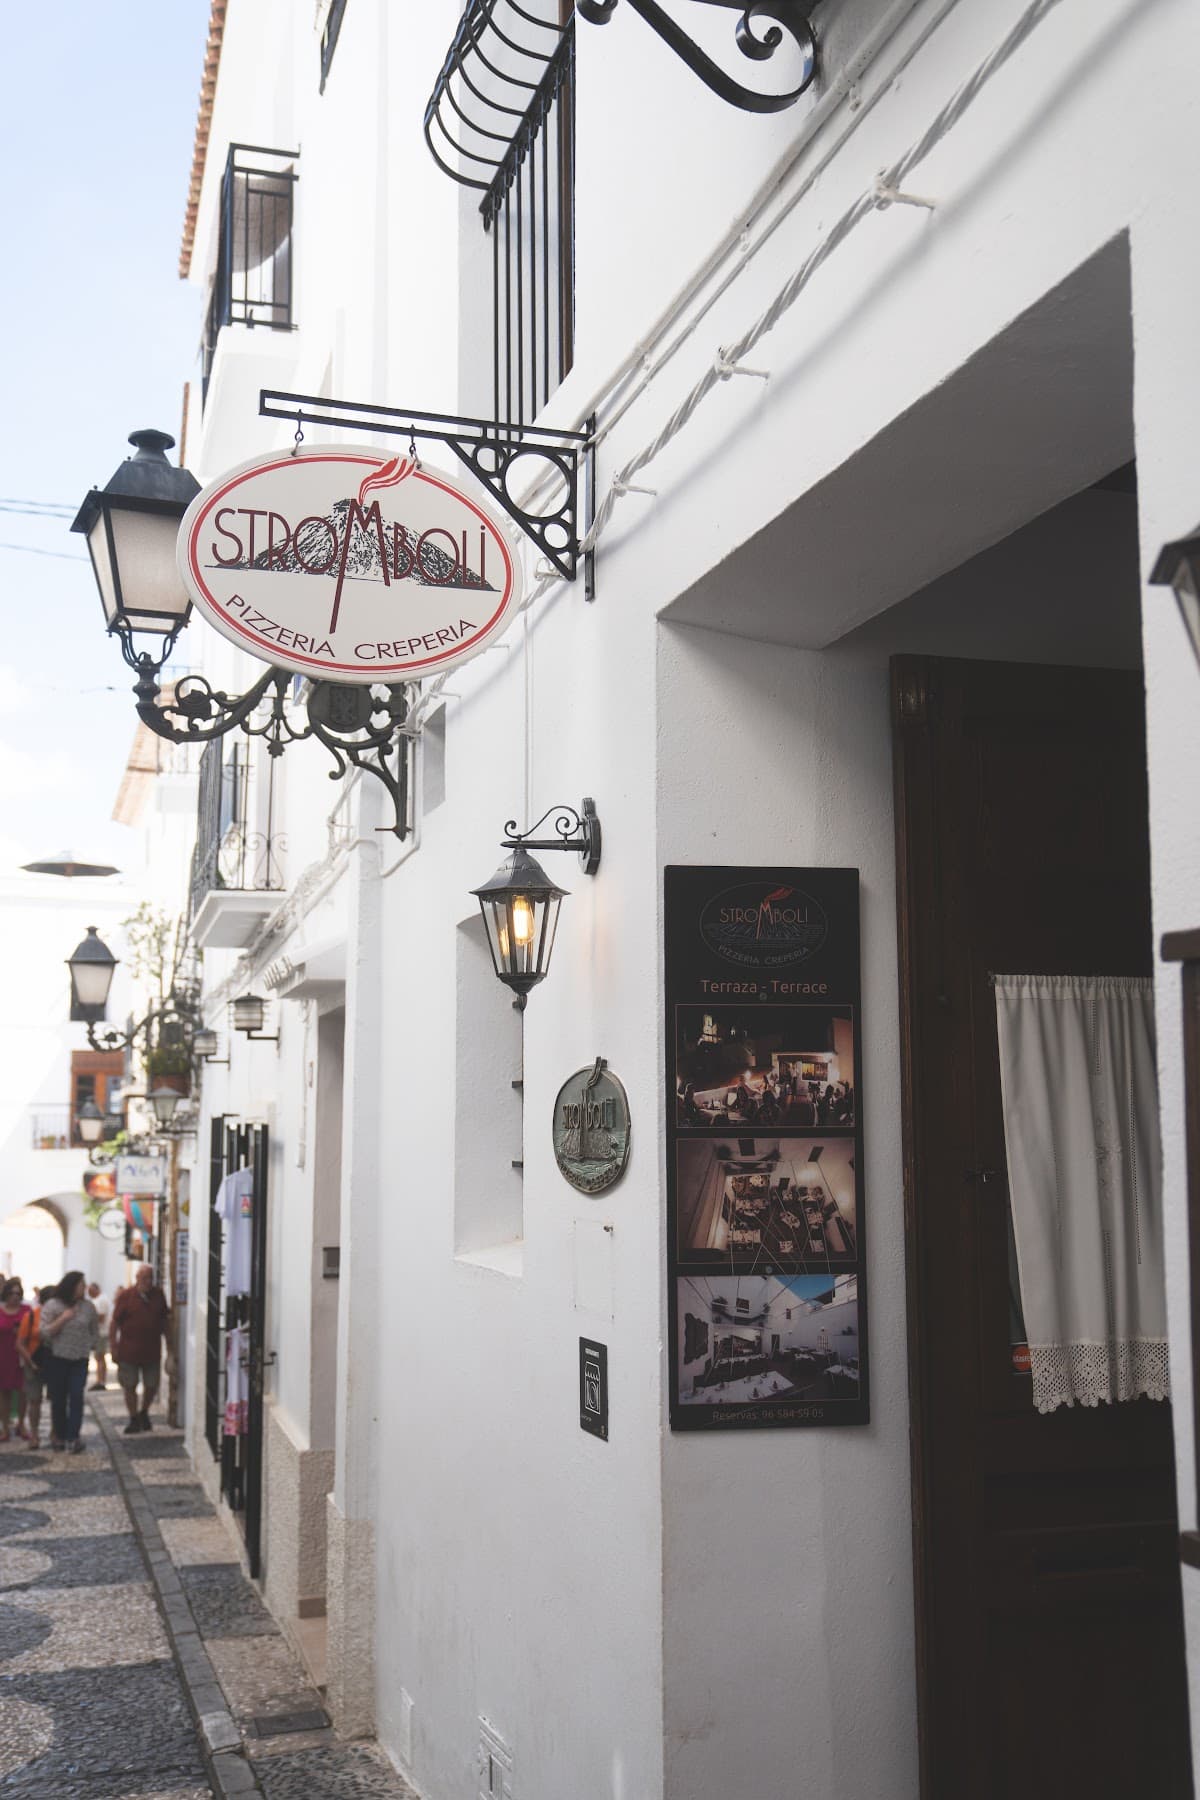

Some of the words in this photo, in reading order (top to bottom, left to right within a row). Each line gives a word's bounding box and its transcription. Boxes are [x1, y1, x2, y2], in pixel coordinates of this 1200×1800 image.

[225, 594, 336, 658] PIZZERIA
[354, 619, 478, 660] CREPERIA
[701, 979, 757, 993] Terraza
[770, 980, 828, 993] Terrace
